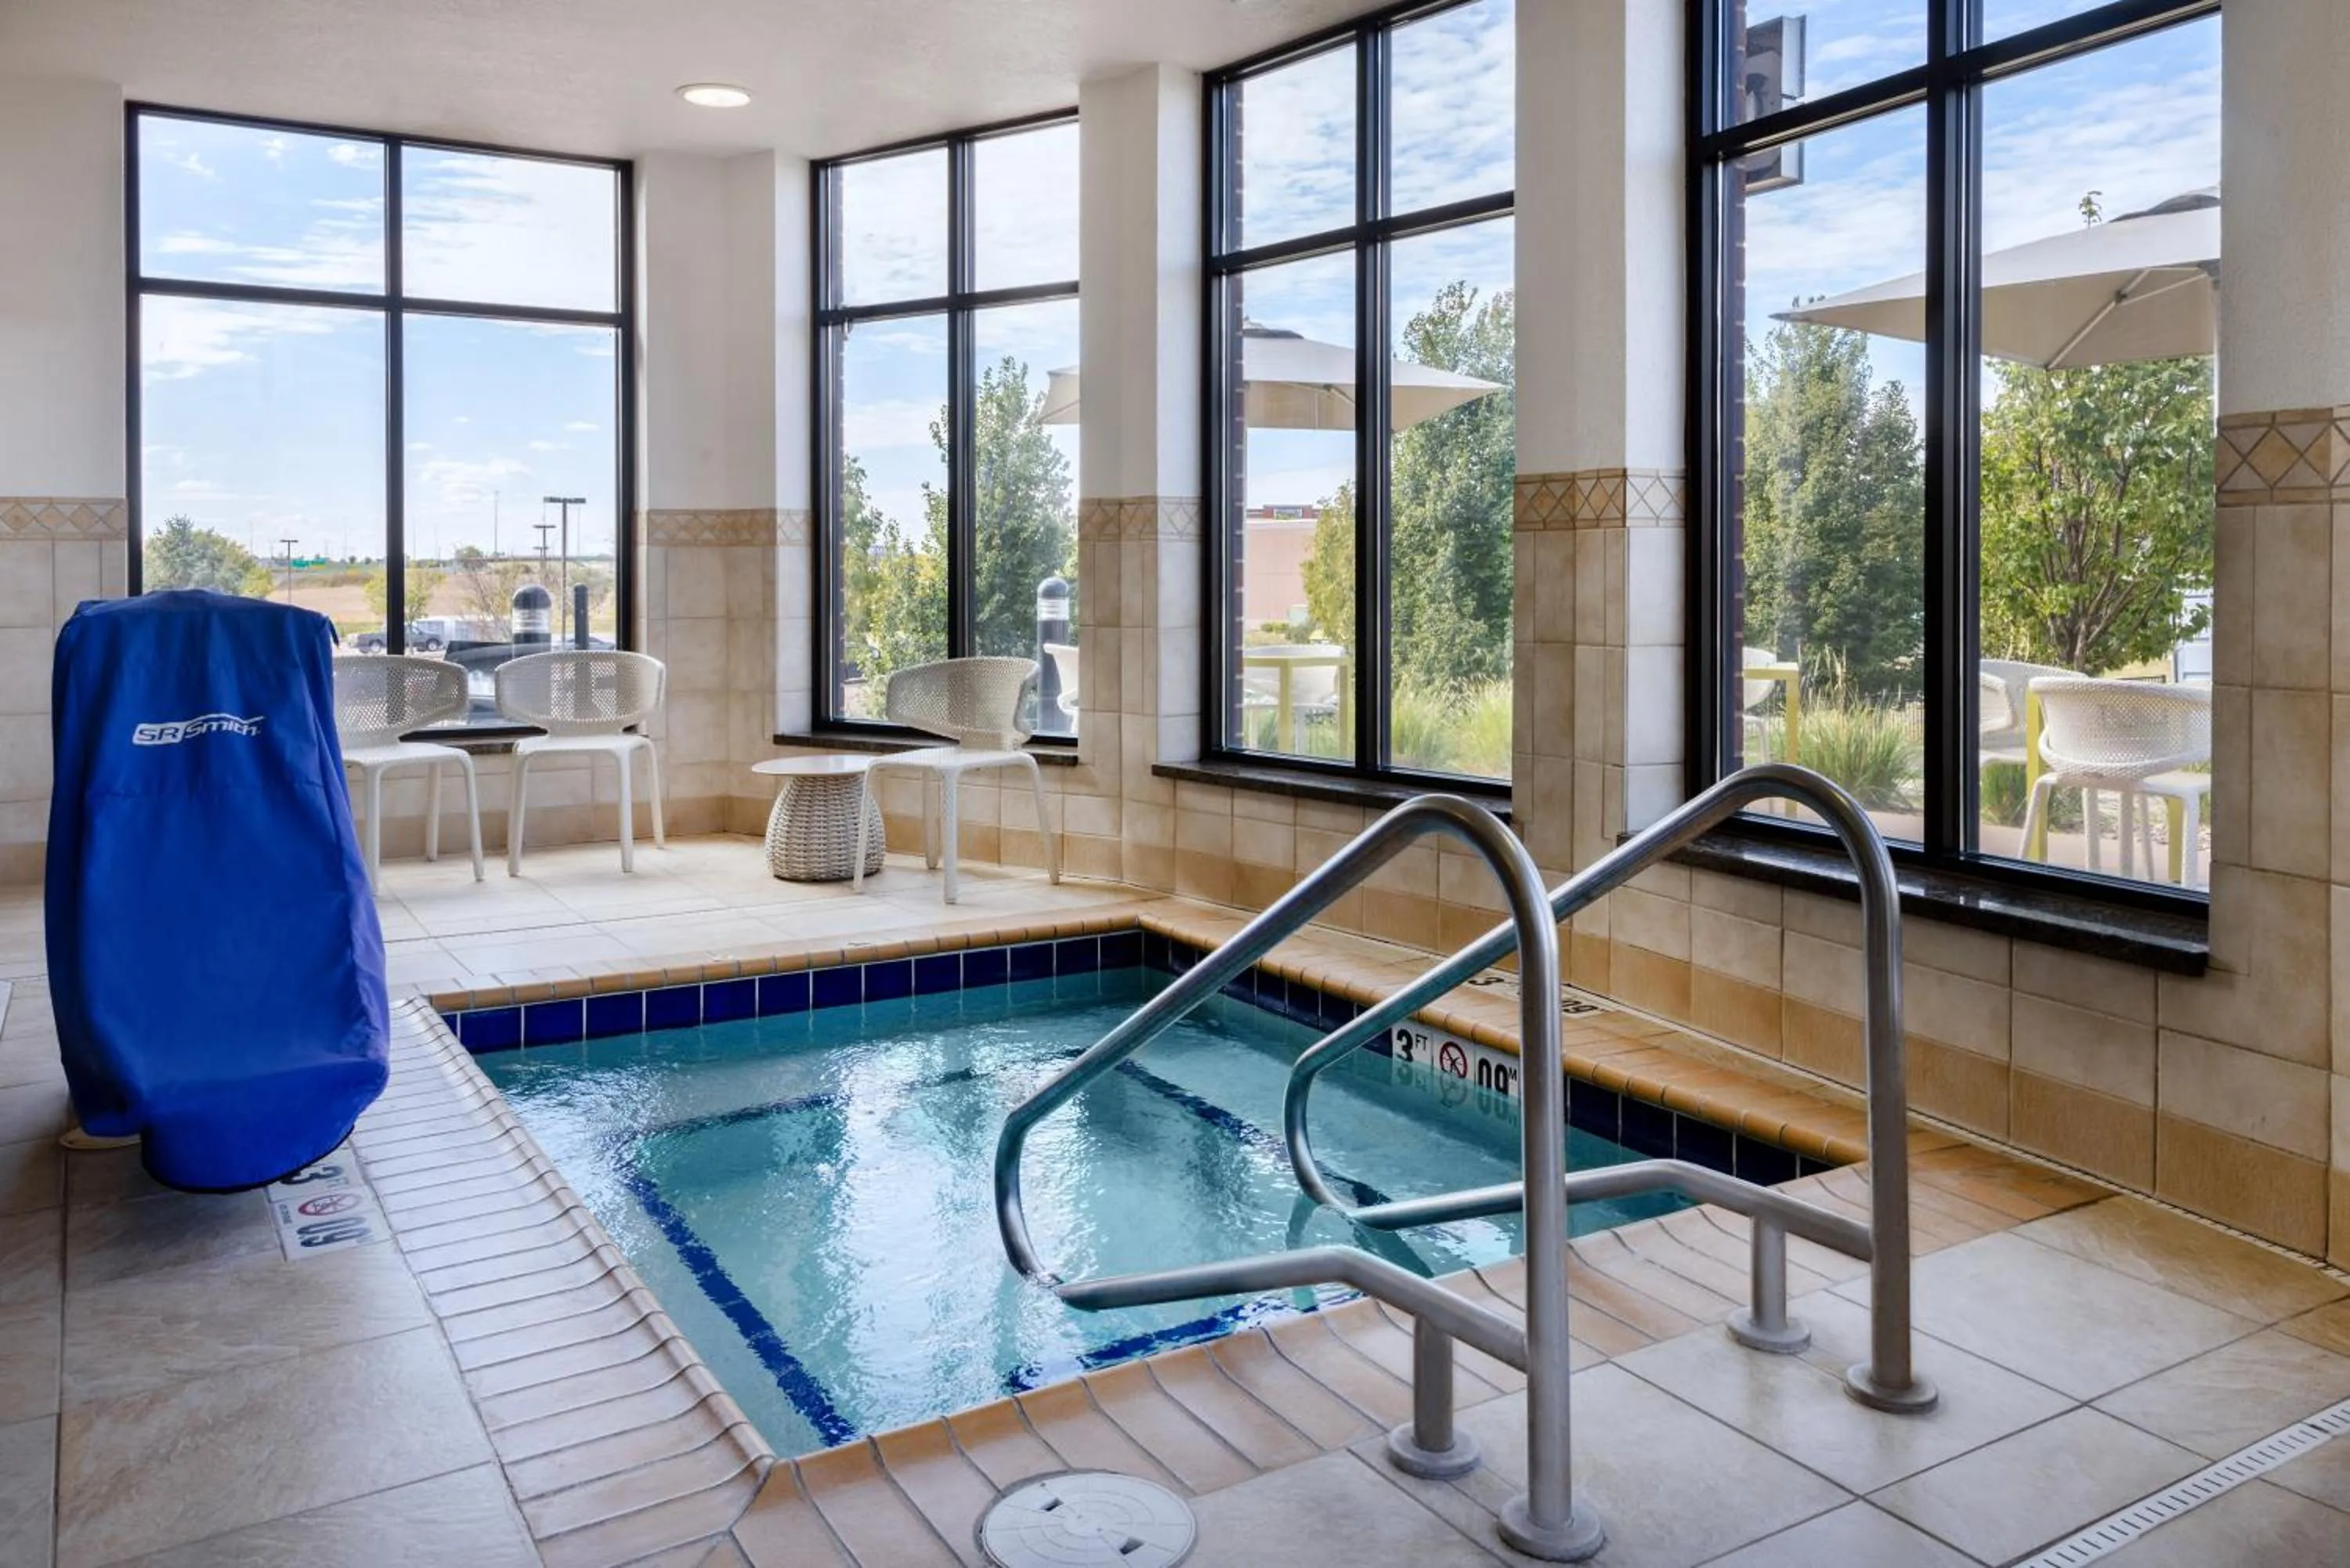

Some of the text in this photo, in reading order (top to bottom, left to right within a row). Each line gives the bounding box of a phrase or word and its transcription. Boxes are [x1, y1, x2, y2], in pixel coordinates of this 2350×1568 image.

[136, 719, 258, 742] SR Smith
[1396, 1028, 1414, 1063] 3
[1415, 1033, 1428, 1052] FT
